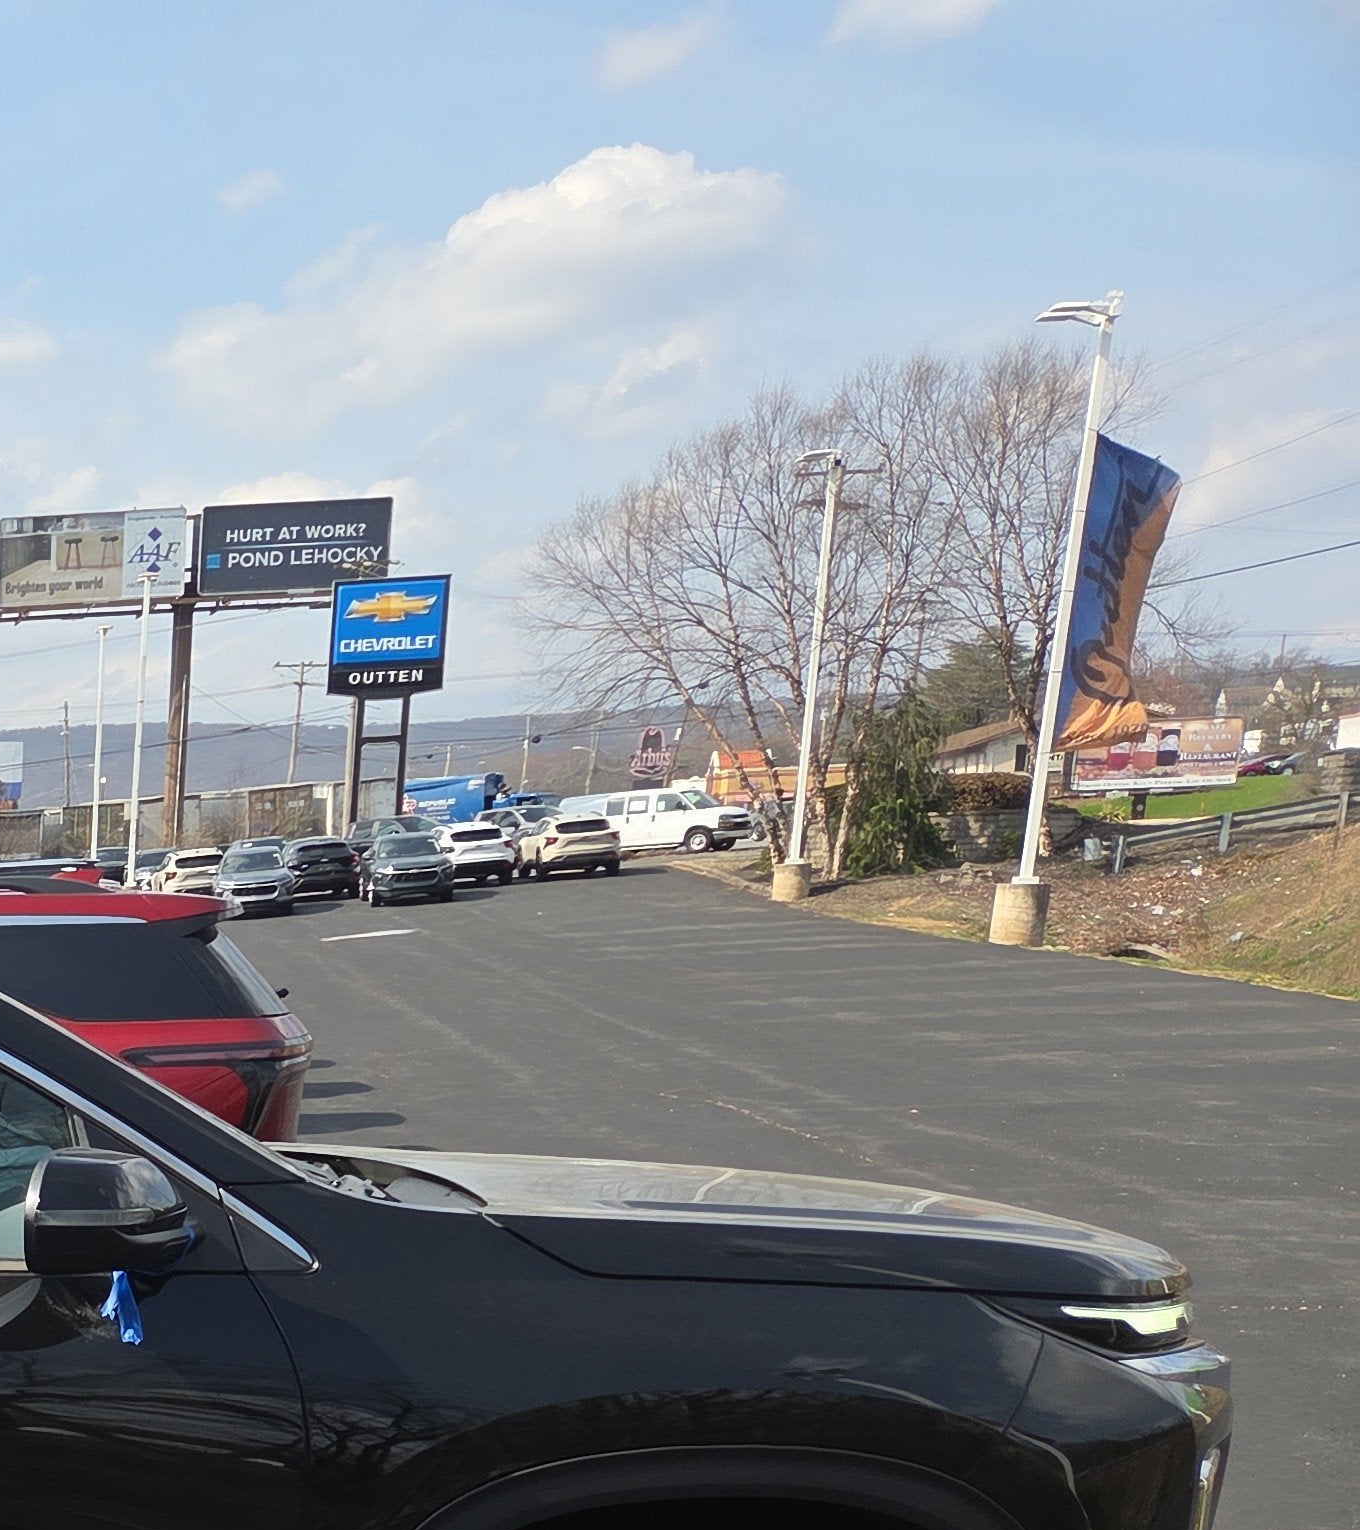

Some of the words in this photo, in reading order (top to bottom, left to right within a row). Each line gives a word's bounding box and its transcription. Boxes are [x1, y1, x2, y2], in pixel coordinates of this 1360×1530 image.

[225, 527, 274, 543] HURT
[278, 526, 300, 540] AT
[305, 523, 367, 539] WORK?
[127, 541, 181, 563] AAF
[227, 550, 284, 568] POND
[290, 546, 383, 566] LEHOCKY
[49, 581, 72, 595] your
[75, 576, 103, 590] world
[340, 634, 438, 653] CHEVROLET
[348, 669, 424, 685] OUTTEN
